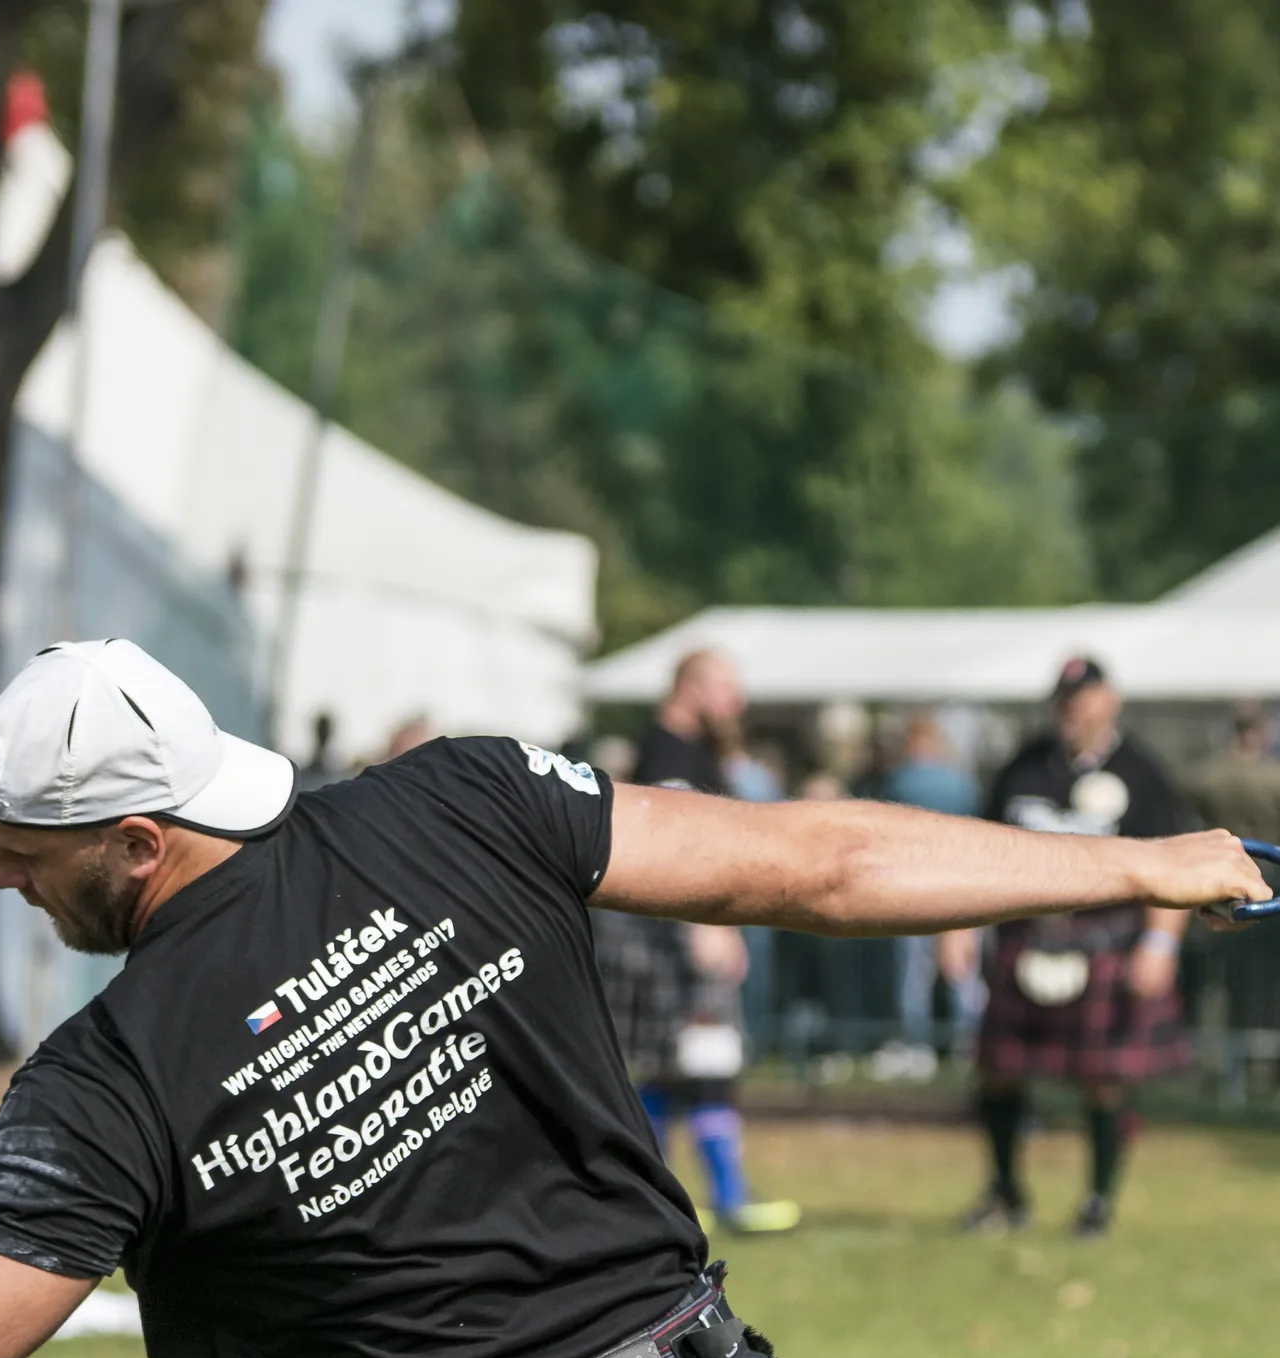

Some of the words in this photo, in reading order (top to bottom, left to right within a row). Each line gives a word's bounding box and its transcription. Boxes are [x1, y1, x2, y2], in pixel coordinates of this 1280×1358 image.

[221, 1062, 262, 1096] WK
[257, 997, 352, 1073] HIGHLAND
[349, 949, 415, 1005] GAMES
[413, 918, 456, 958] 2017
[270, 1055, 314, 1091] HANK
[318, 1031, 347, 1056] THE
[342, 961, 438, 1039] NETHERLANDS
[275, 907, 408, 1013] Tuláček
[278, 1032, 487, 1193] Federatie
